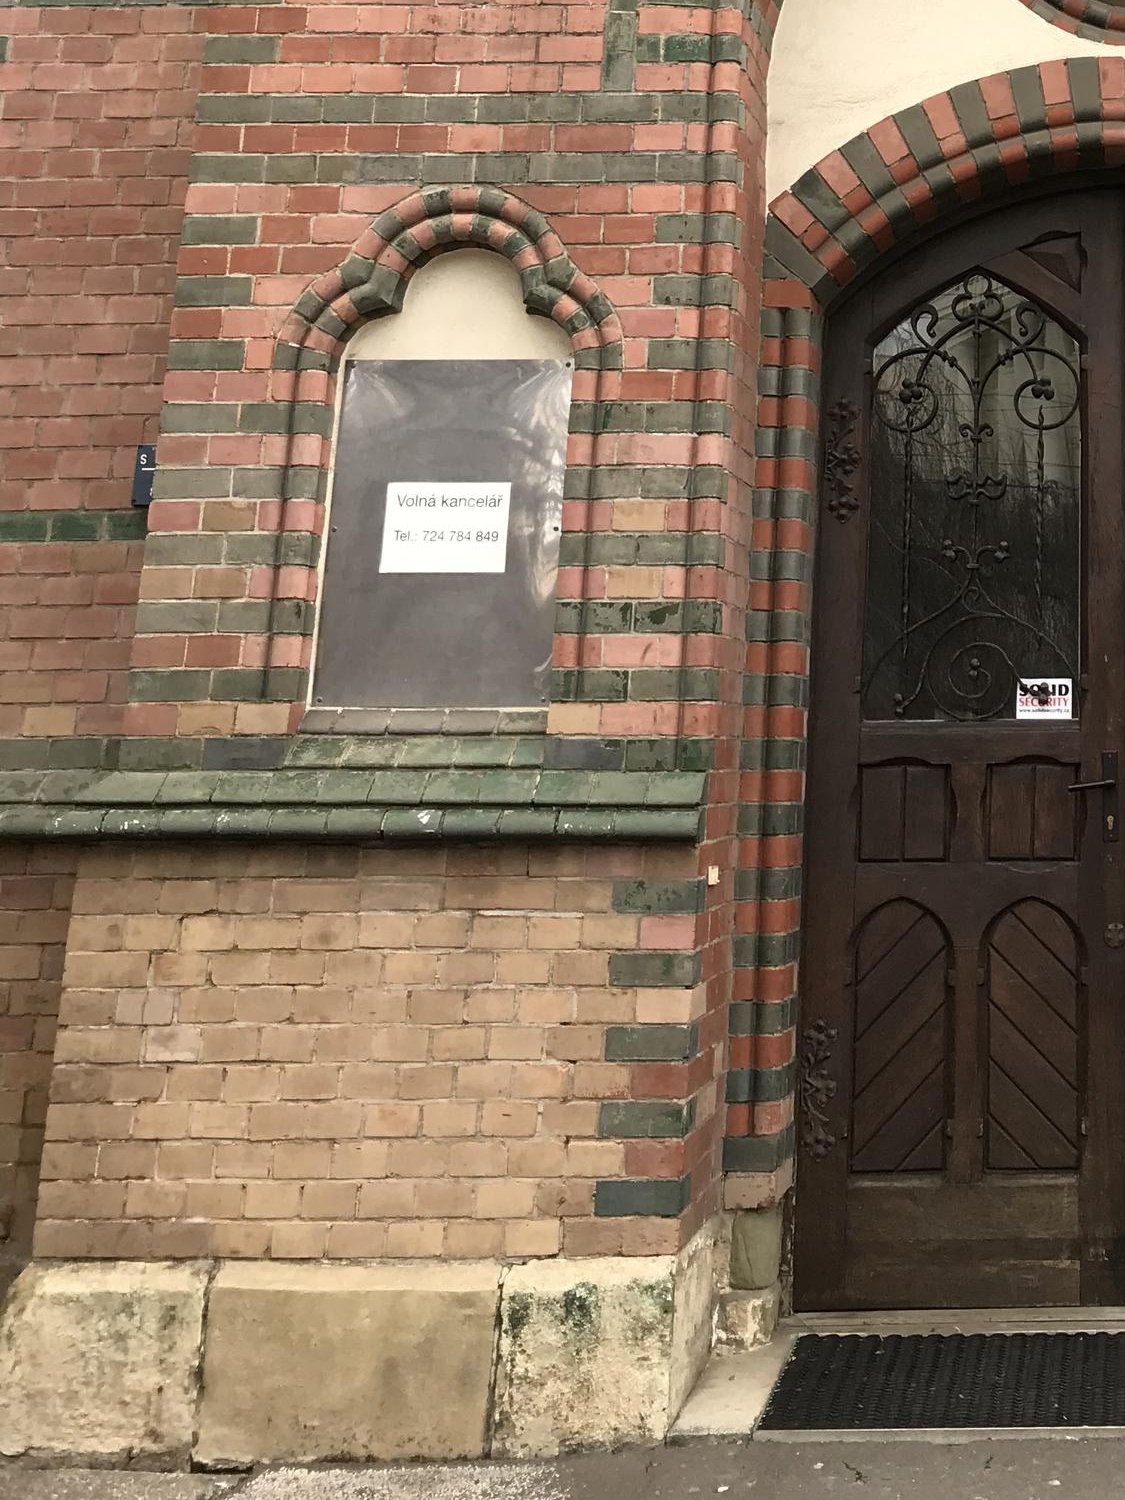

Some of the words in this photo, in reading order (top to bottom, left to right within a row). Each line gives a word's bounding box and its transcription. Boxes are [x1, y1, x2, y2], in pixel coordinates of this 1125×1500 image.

[397, 493, 436, 508] Volná
[441, 494, 503, 508] kancelář
[394, 530, 418, 542] Tel.:
[423, 530, 444, 542] 724
[449, 530, 471, 542] 784
[475, 530, 499, 542] 849
